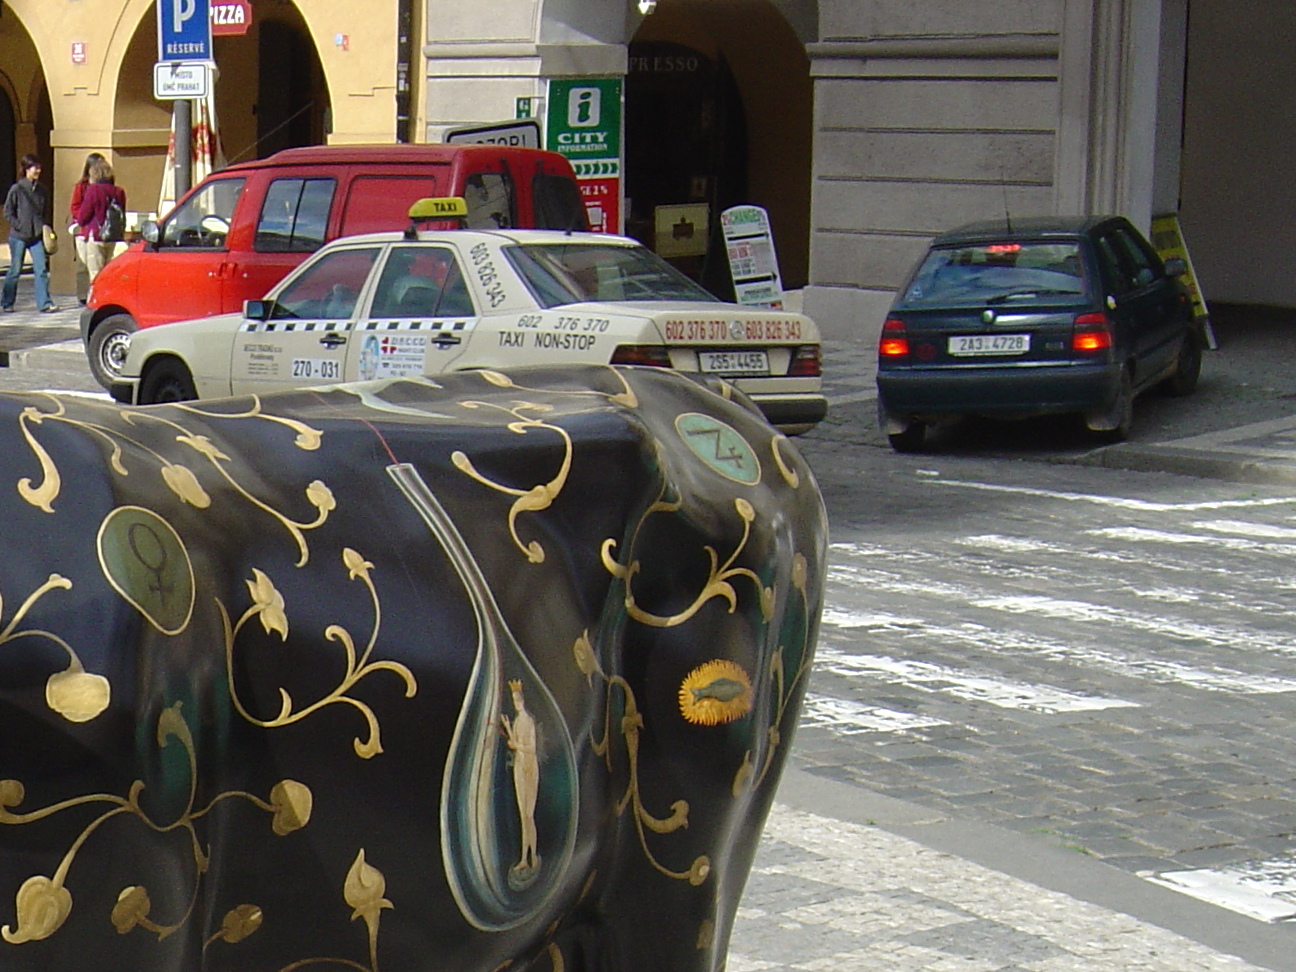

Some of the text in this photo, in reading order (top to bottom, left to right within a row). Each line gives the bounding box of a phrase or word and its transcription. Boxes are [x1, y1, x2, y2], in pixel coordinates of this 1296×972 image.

[166, 41, 205, 54] RÉSERVÉ
[557, 132, 608, 144] CITY
[557, 143, 608, 154] INFORMATION
[433, 202, 457, 213] TAXI
[470, 242, 506, 308] 603 826 343
[517, 315, 610, 332] 602 376 370
[665, 320, 727, 340] 602 376 370
[745, 320, 801, 340] 603 826 343
[498, 331, 596, 350] TAXI NON-STOP
[959, 336, 1023, 351] 2A3 4728
[293, 360, 312, 378] 270
[321, 361, 339, 378] 031
[709, 353, 764, 370] 2S5 4455
